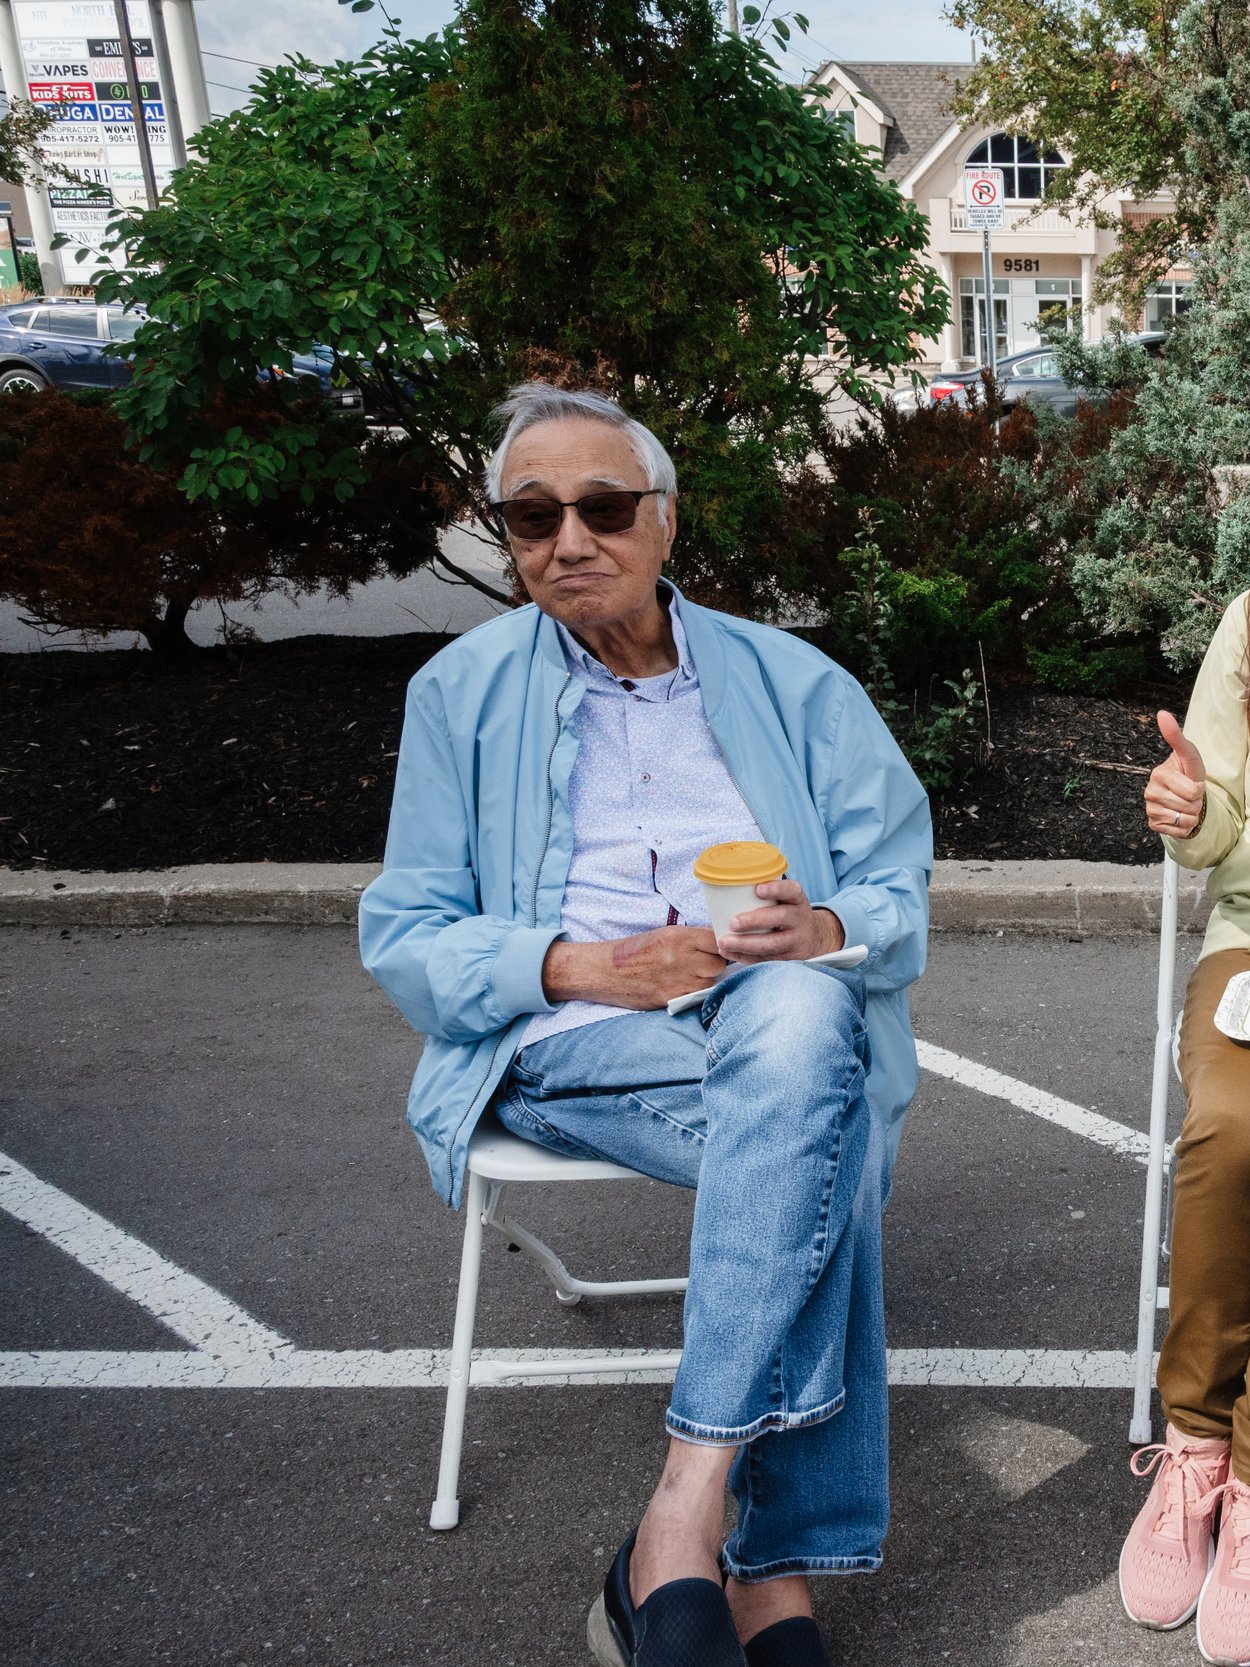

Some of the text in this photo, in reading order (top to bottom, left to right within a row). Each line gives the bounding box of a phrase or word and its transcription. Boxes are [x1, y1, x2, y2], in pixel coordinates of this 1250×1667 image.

[71, 5, 105, 17] NORTH
[102, 41, 141, 55] EMI'S
[43, 64, 88, 77] VAPES
[92, 61, 156, 79] CONVENCE
[32, 90, 91, 99] KIDS KUTS
[100, 104, 165, 120] DENAL
[104, 125, 134, 134] WOW!
[966, 172, 1000, 180] FIRE ROUTE
[50, 189, 111, 200] PIZZAI
[90, 210, 114, 221] FACTO
[1003, 258, 1040, 272] 9581
